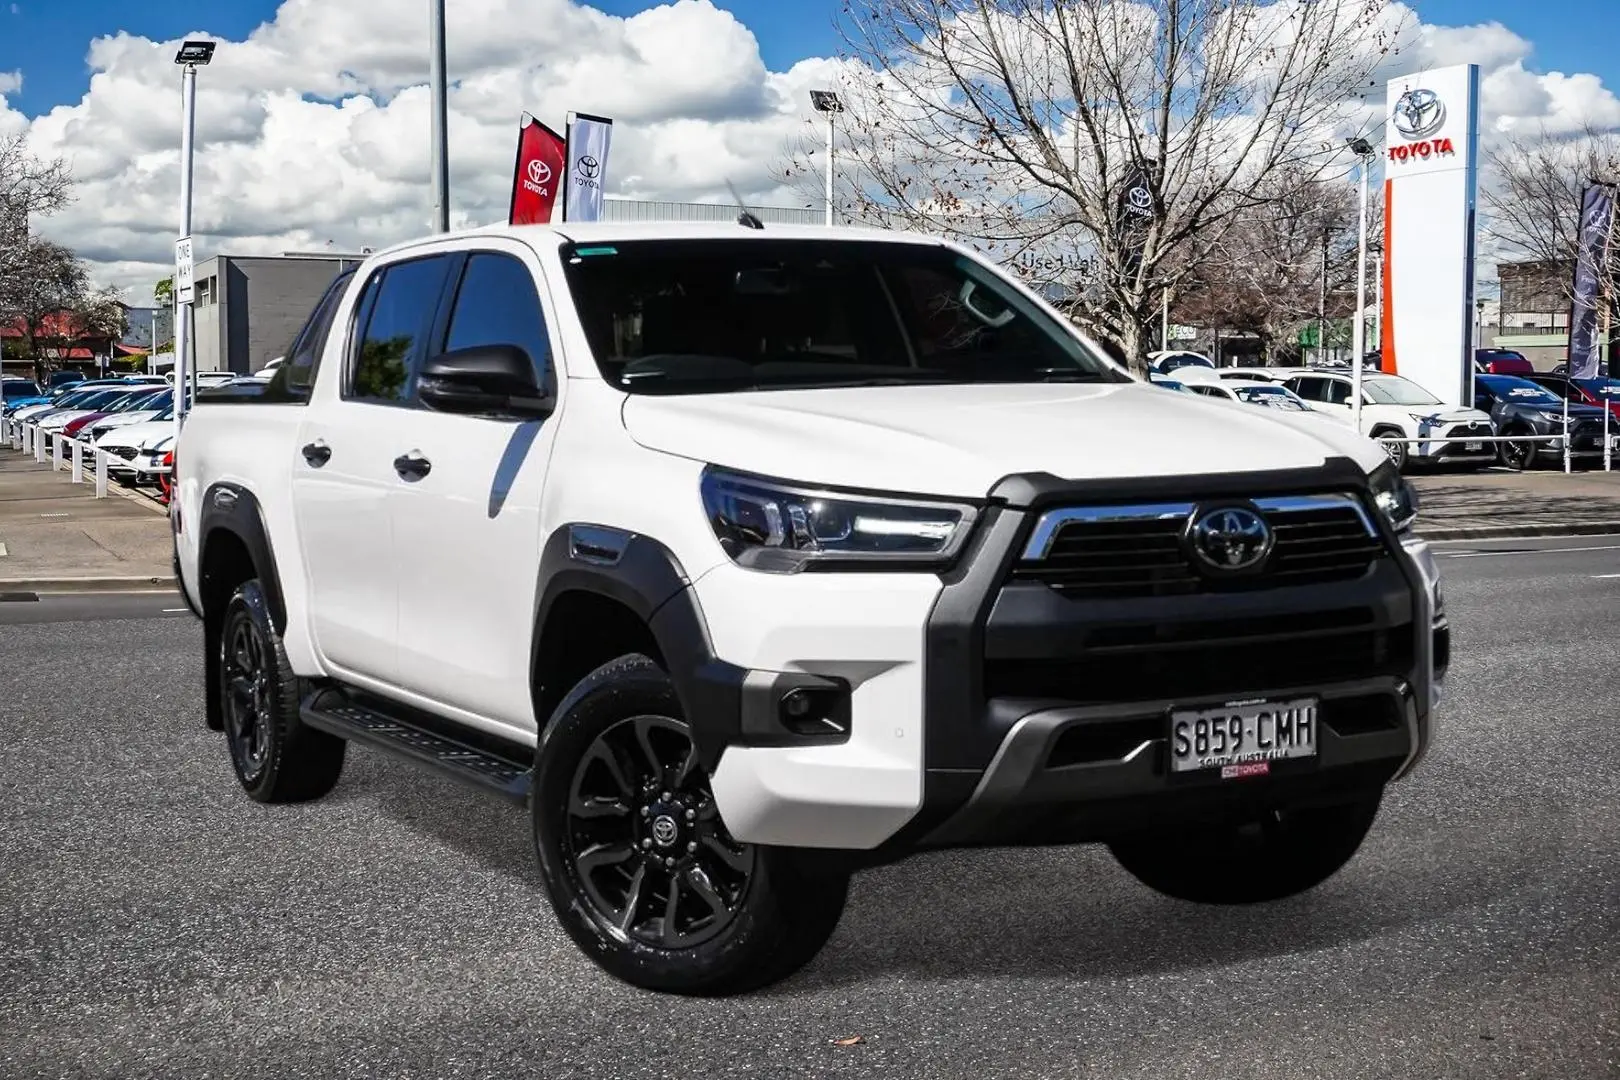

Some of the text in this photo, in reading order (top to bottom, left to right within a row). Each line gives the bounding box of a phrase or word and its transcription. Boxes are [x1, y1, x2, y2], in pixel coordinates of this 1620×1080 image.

[1388, 138, 1454, 161] TOYOTA
[523, 179, 548, 197] TOYOTA
[178, 243, 190, 261] ONE
[178, 265, 191, 279] WAY
